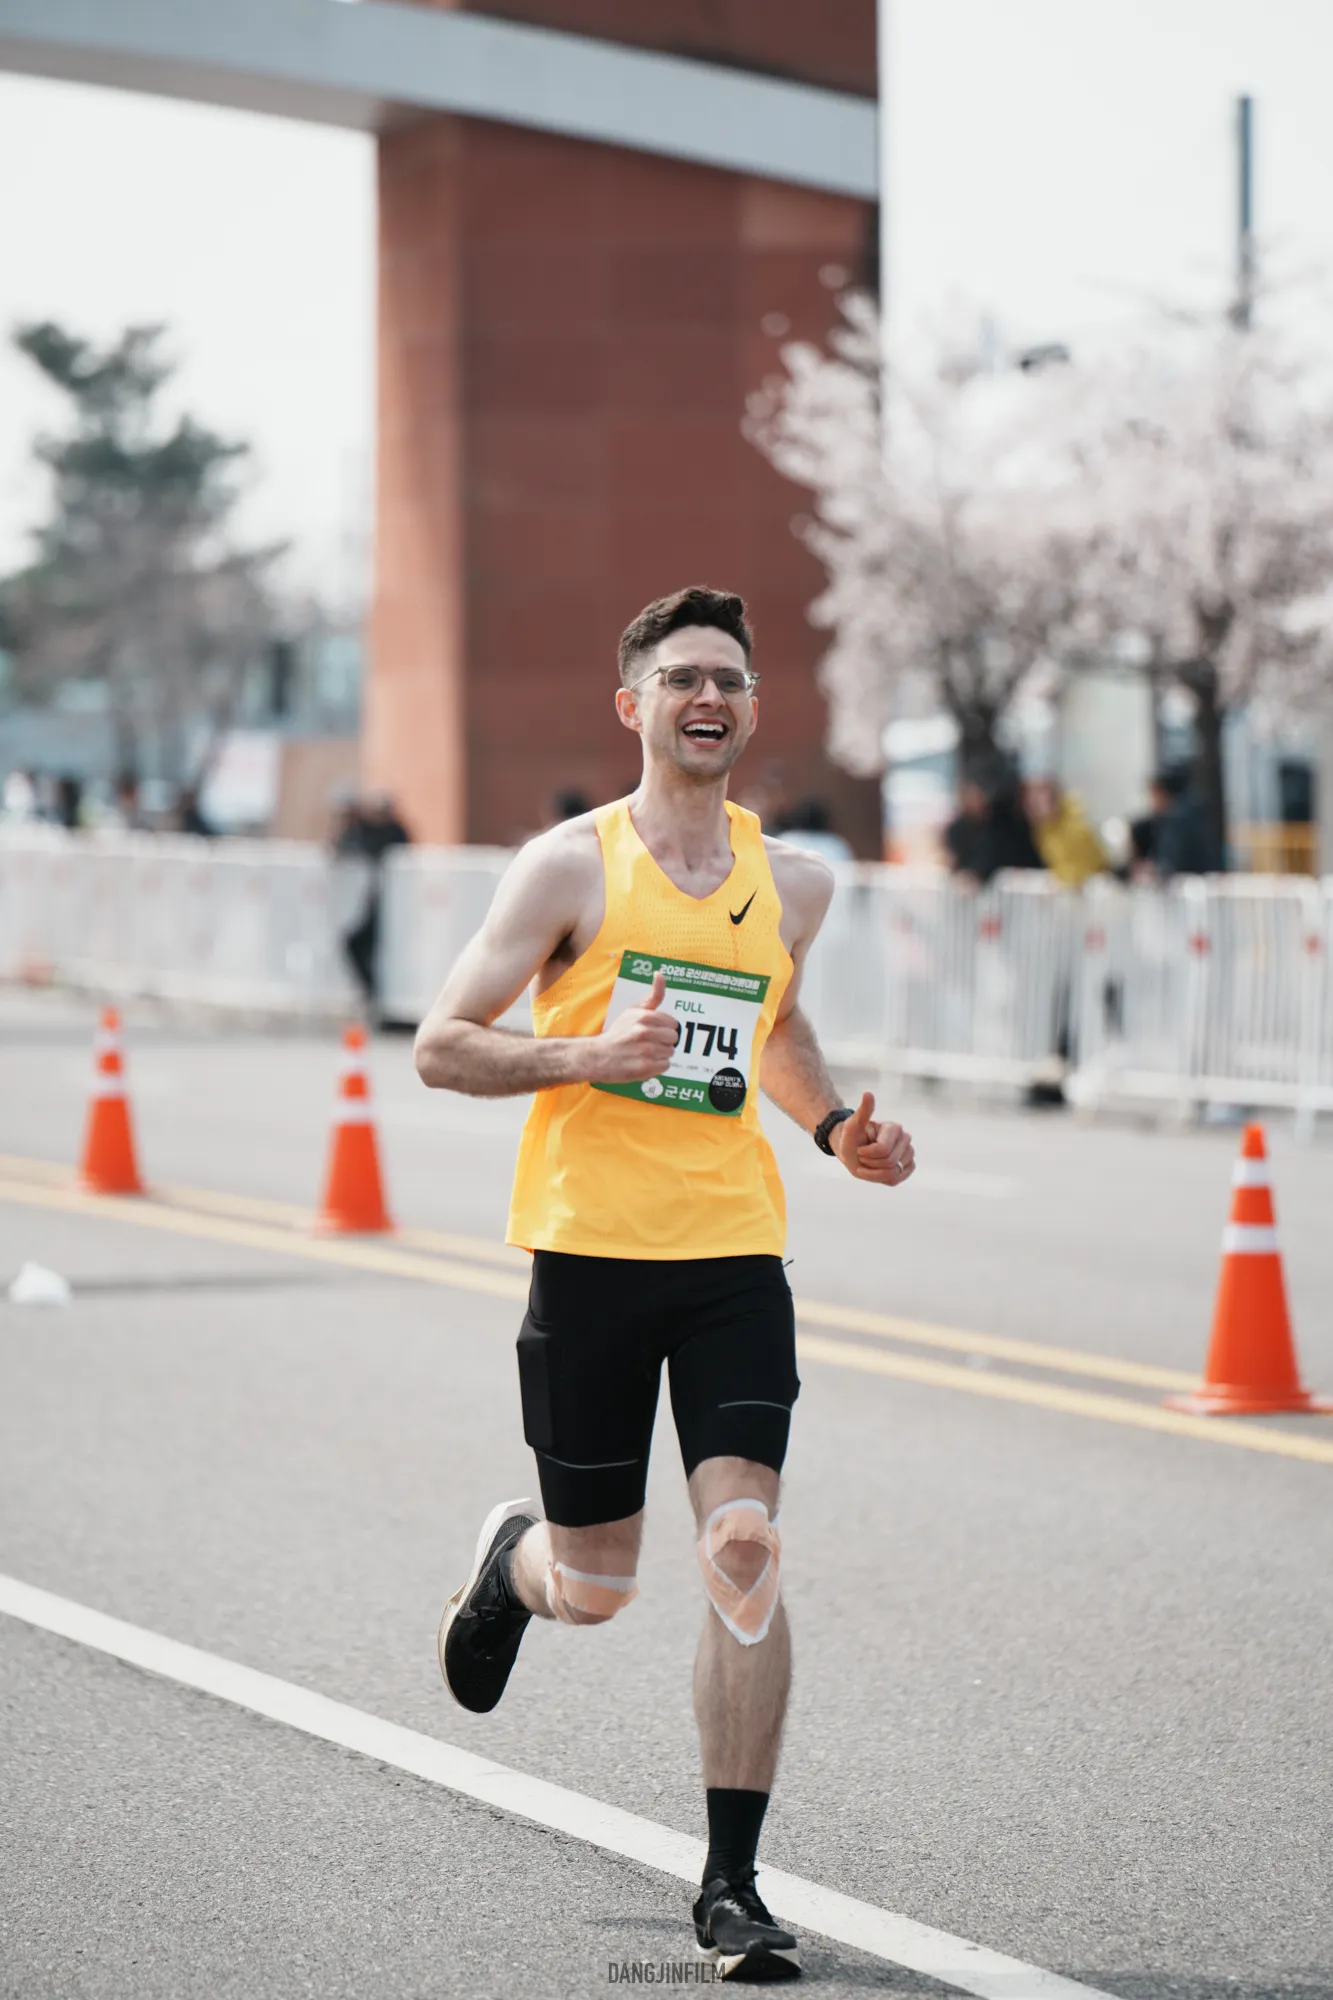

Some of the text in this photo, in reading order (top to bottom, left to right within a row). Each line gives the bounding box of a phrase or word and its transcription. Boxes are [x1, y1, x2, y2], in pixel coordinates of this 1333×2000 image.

[659, 963, 686, 977] 2026
[674, 1000, 705, 1014] FULL
[664, 1085, 705, 1103] 군산시
